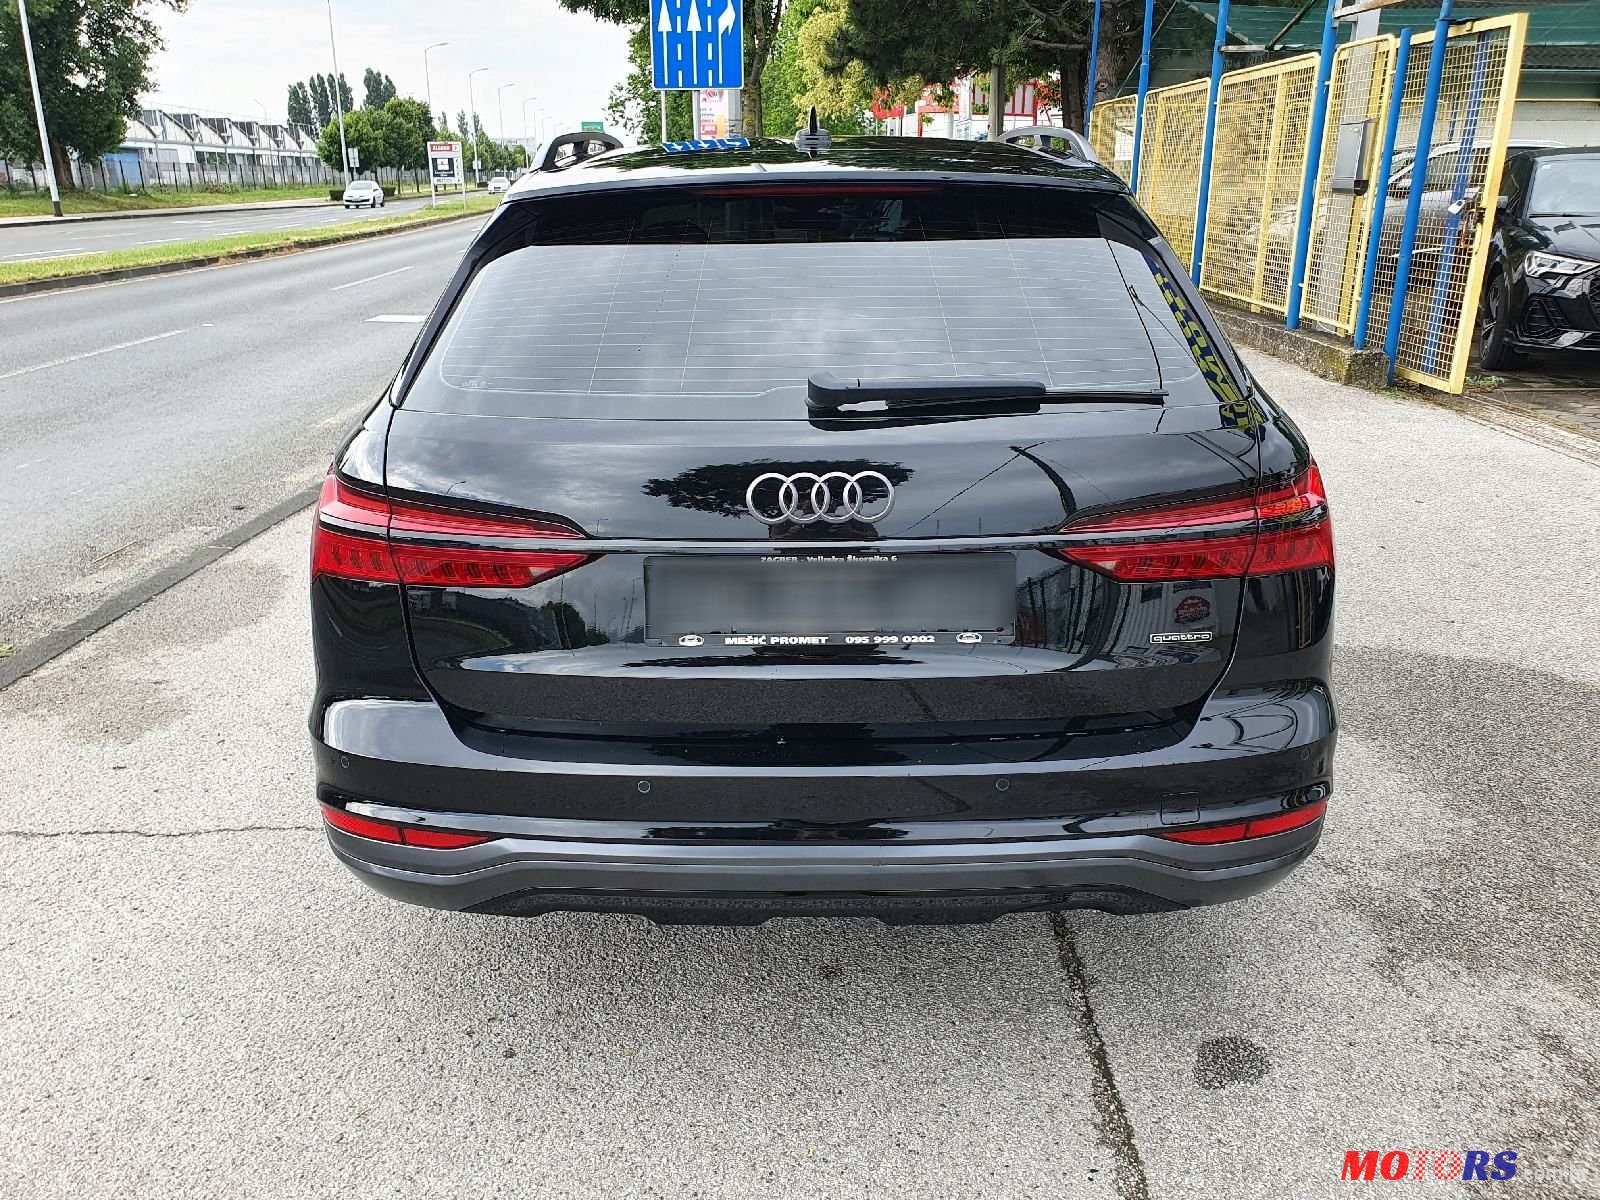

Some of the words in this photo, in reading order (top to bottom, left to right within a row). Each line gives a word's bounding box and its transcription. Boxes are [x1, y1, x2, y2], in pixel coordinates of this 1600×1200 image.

[770, 636, 828, 645] PROMET
[845, 636, 870, 644] 095
[873, 635, 899, 644] 999
[902, 635, 936, 643] 0202
[1153, 633, 1210, 642] quattro
